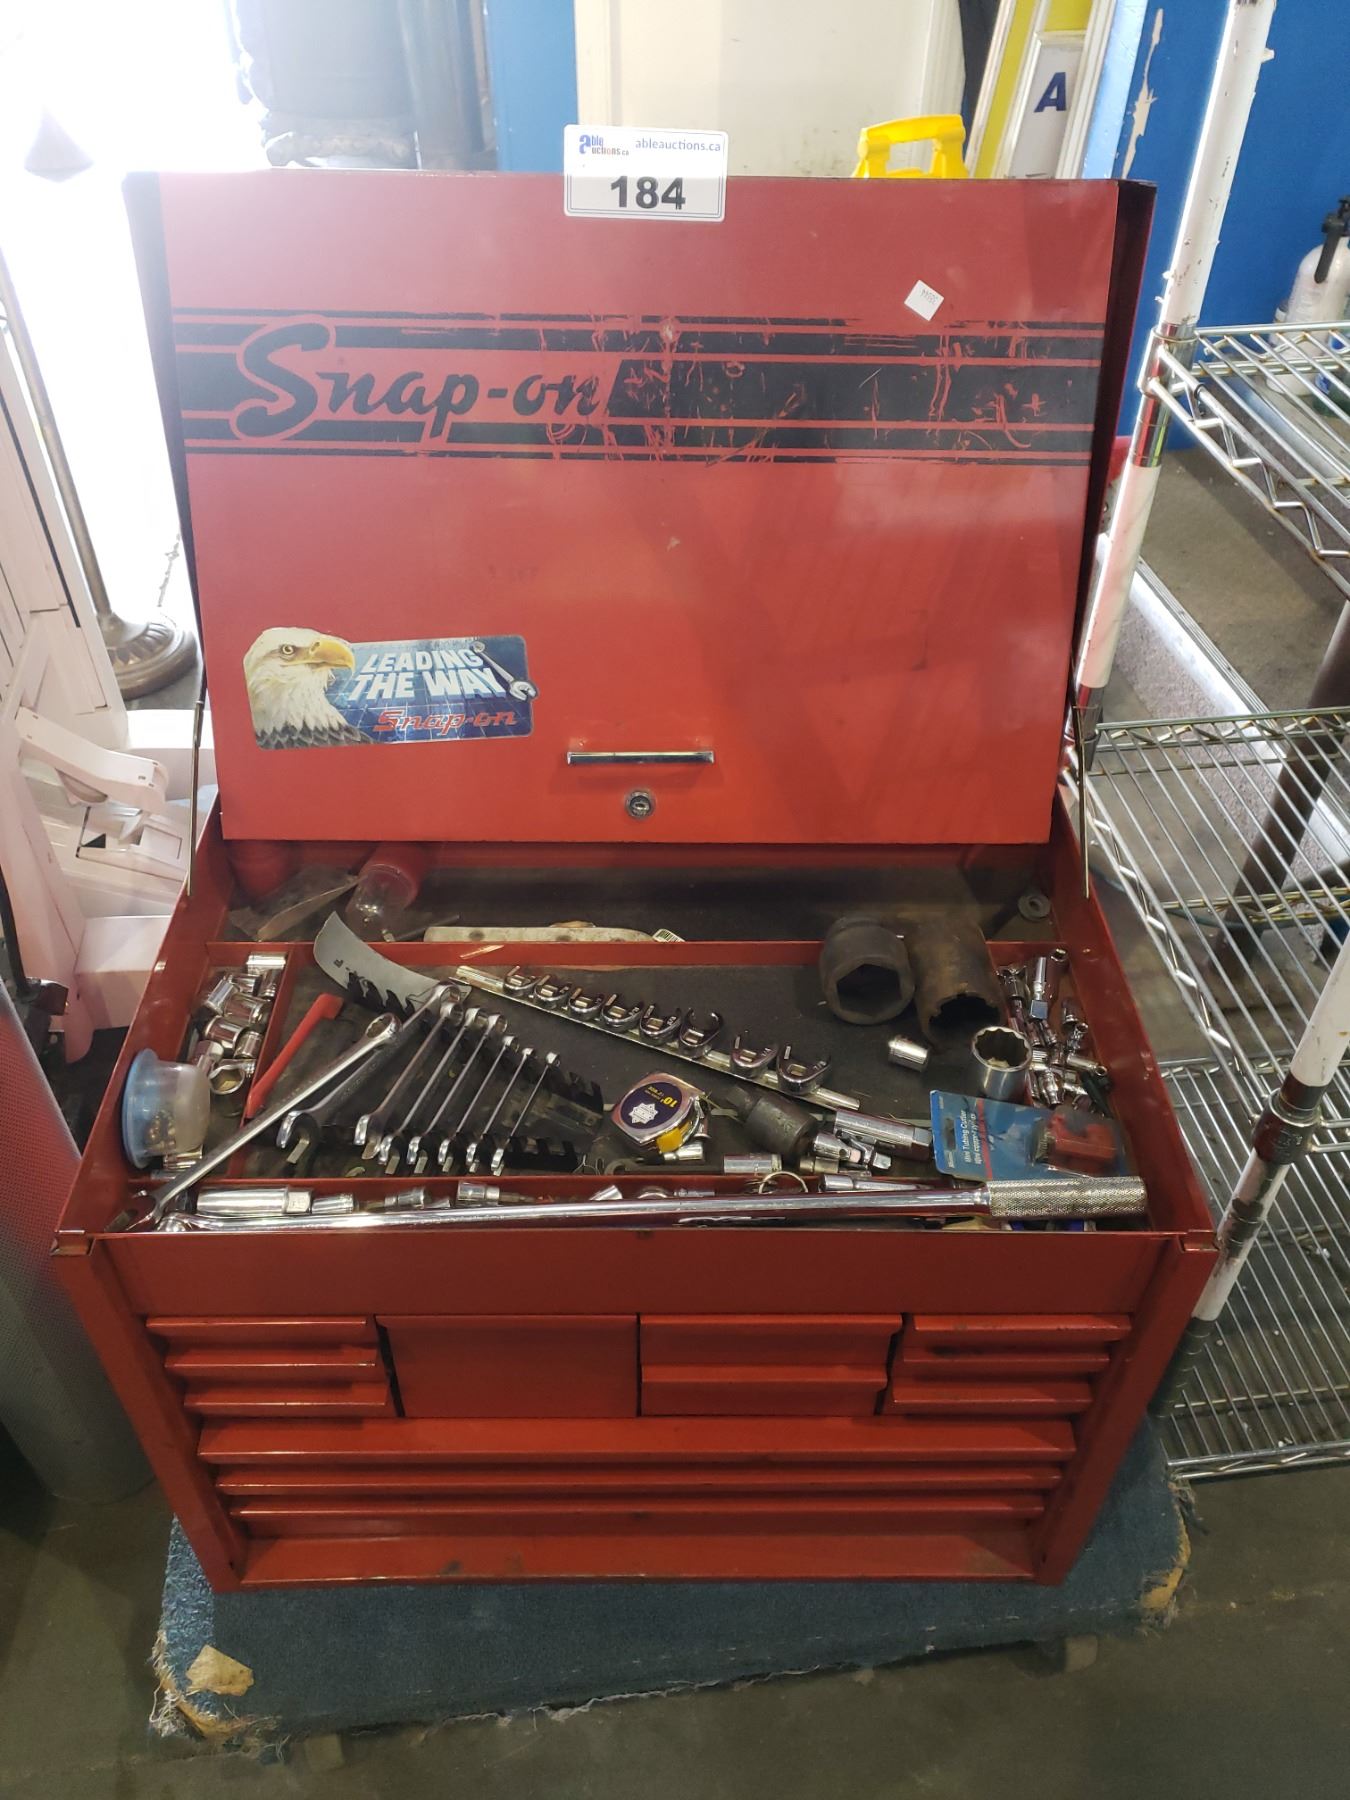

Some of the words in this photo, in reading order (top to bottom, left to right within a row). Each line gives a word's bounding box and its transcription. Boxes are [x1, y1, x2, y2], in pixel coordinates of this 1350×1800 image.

[1034, 71, 1067, 113] A
[635, 138, 721, 152] ableauctions.ca
[610, 175, 686, 210] 184
[236, 322, 602, 439] Snap-on
[360, 648, 484, 674] LEADING
[347, 672, 415, 701] THE
[423, 667, 507, 700] WAY
[372, 710, 518, 737] Snap-on
